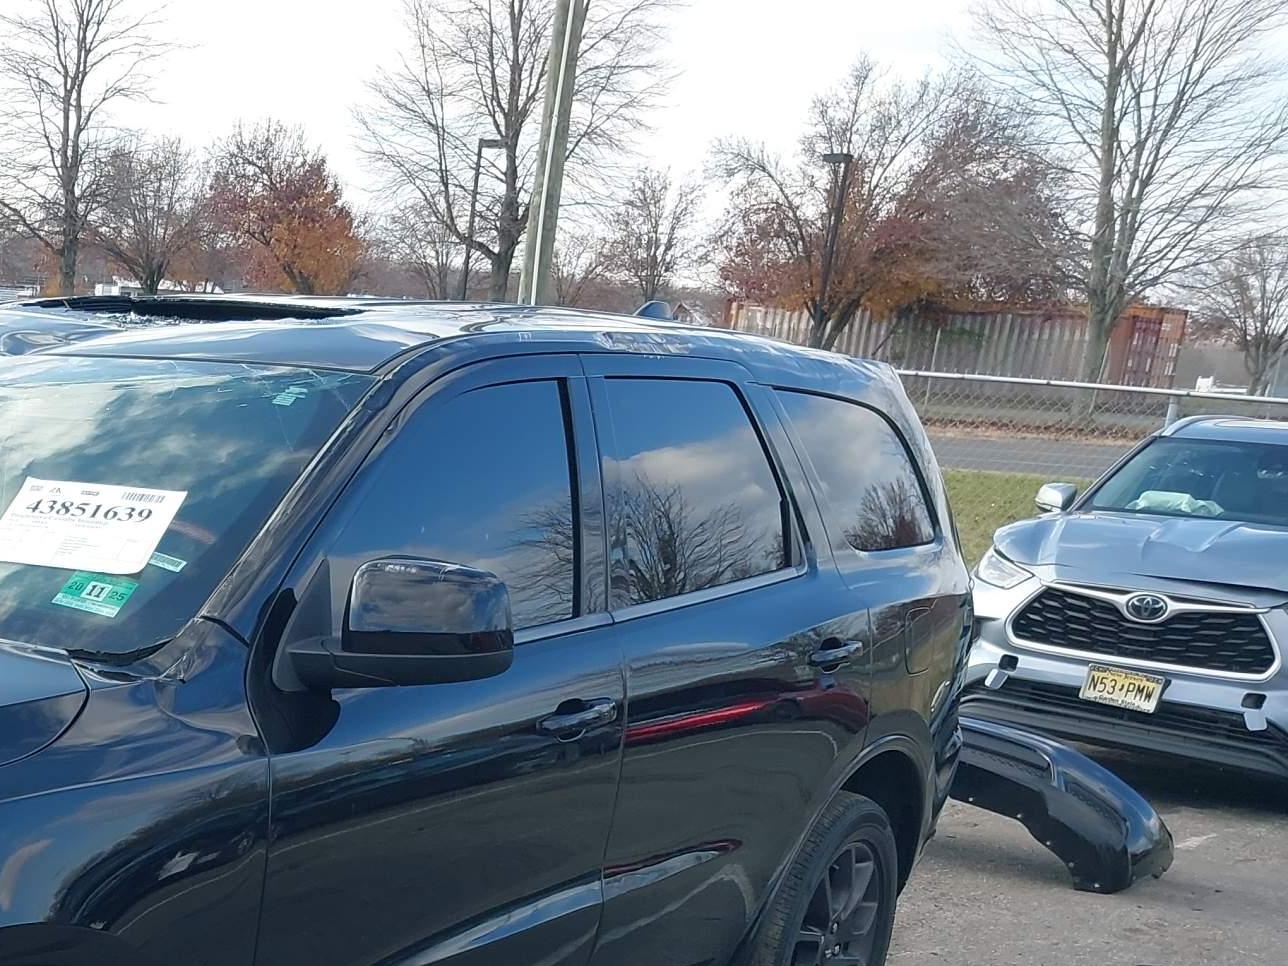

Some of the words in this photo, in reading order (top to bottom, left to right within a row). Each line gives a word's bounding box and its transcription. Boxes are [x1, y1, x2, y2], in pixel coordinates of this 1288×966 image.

[25, 496, 154, 524] 43851639
[67, 580, 84, 592] 20
[85, 584, 106, 599] 11
[108, 590, 129, 602] 25
